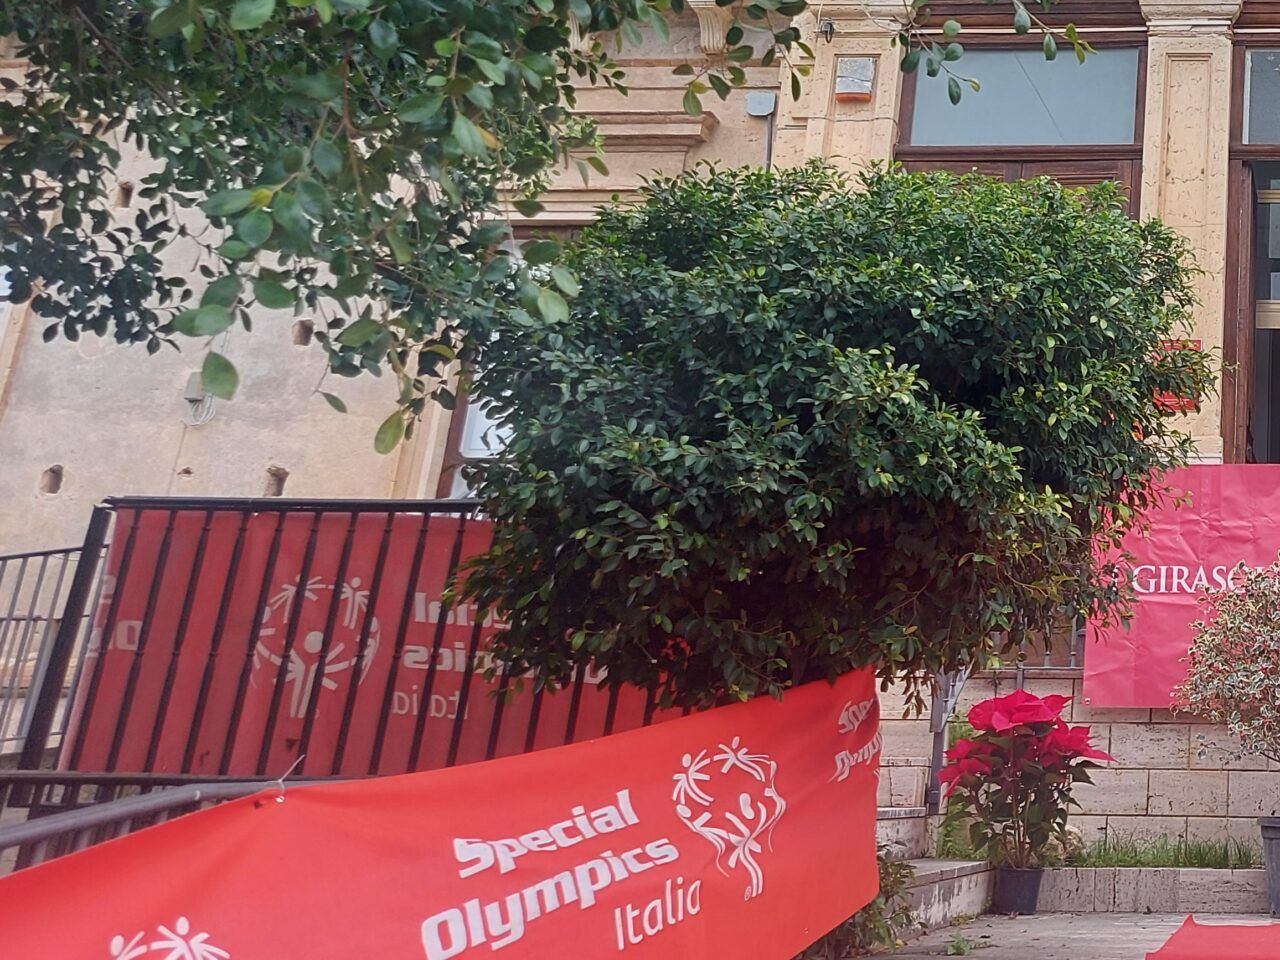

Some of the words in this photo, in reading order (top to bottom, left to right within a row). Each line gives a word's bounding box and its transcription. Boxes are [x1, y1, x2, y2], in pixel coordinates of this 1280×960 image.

[453, 789, 641, 879] Special
[421, 838, 680, 960] Olympics
[614, 876, 702, 951] Italia
